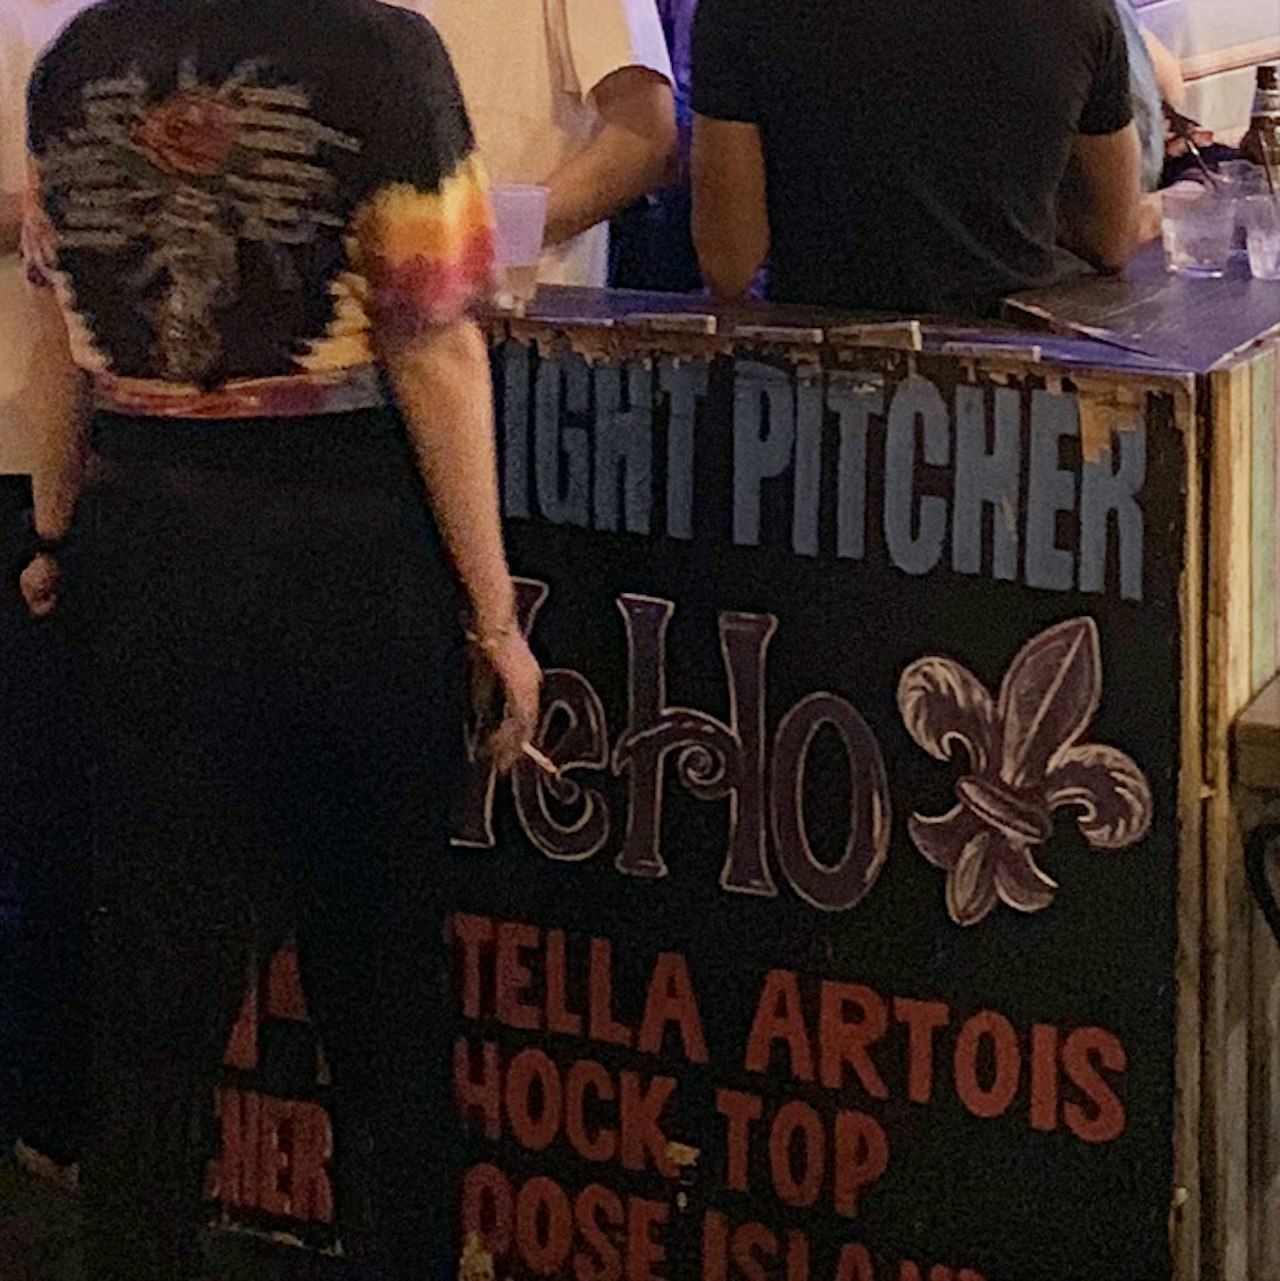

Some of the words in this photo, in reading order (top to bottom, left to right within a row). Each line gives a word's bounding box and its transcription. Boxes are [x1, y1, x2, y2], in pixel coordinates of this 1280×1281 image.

[733, 359, 1147, 601] PITCHER
[450, 576, 893, 912] eHo
[716, 1088, 889, 1218] TOP
[745, 968, 1128, 1144] ARTOIS
